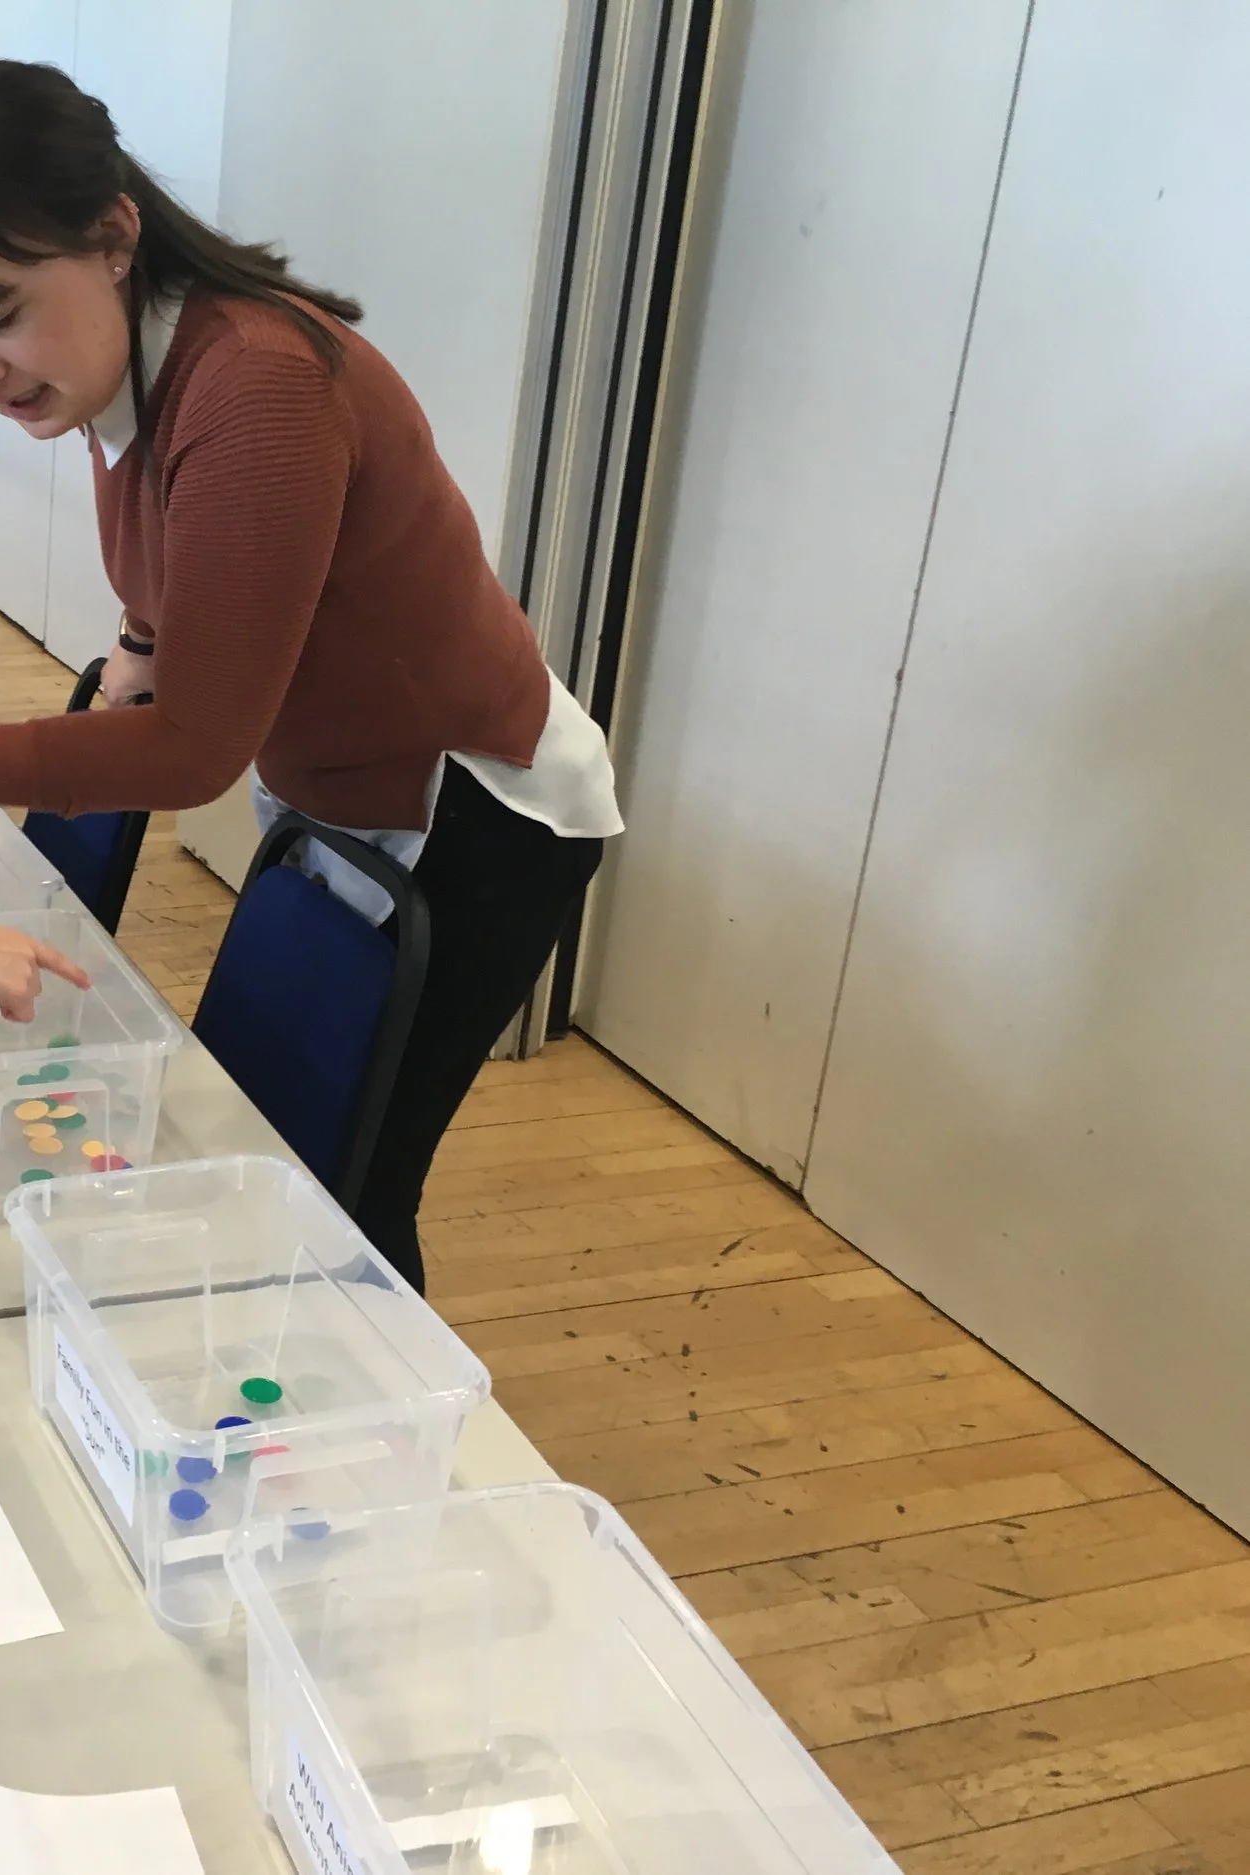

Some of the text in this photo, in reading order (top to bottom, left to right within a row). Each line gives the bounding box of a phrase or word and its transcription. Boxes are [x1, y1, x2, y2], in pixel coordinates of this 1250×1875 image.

[56, 1343, 130, 1472] Family Fun in the
[288, 1782, 333, 1875] Advent
[296, 1752, 324, 1822] Wild
